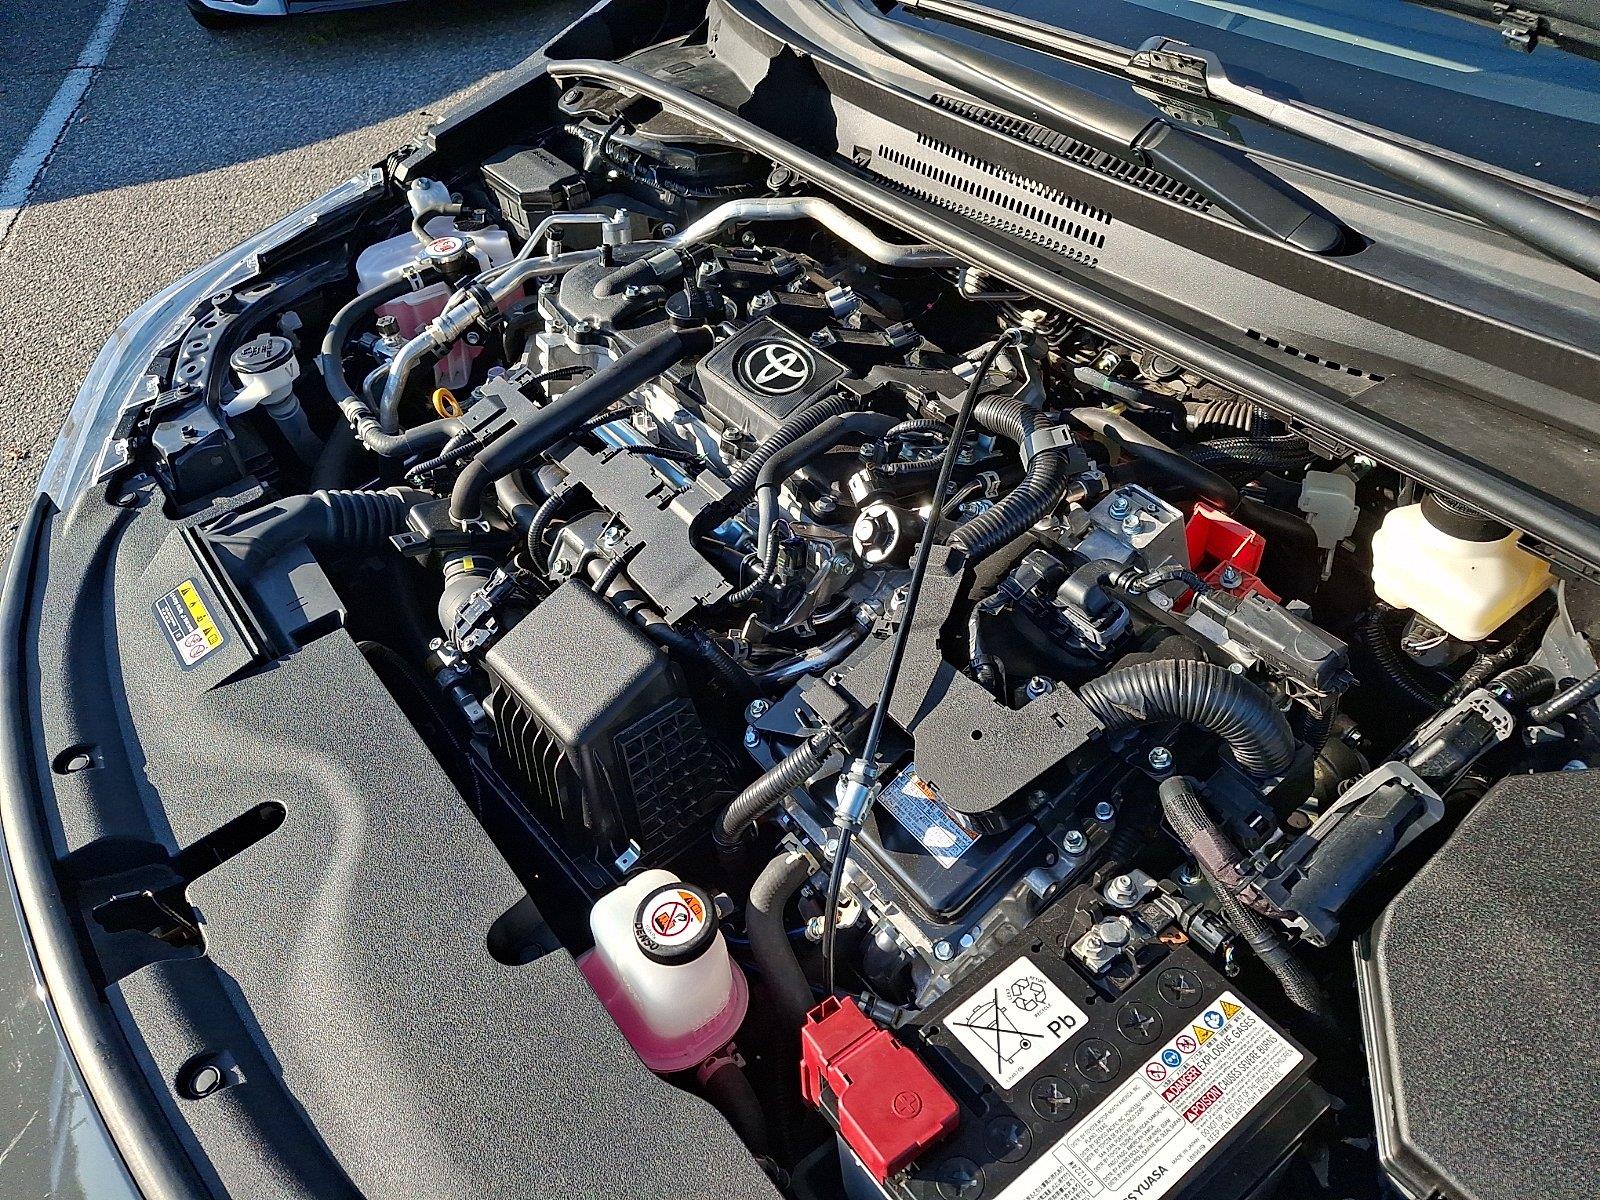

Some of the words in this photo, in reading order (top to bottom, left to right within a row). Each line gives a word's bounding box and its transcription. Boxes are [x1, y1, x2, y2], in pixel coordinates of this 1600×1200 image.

[635, 922, 660, 950] DENSO
[1047, 1013, 1076, 1038] Pb
[1170, 1065, 1200, 1096] DANGER
[1197, 1035, 1235, 1070] EXPLOSIVE
[1232, 1016, 1256, 1038] GASES
[1191, 1087, 1221, 1116] POISON
[1218, 1068, 1242, 1090] CAUSES
[1238, 1050, 1261, 1072] SEVERE
[1256, 1035, 1277, 1054] BURNS
[1133, 1166, 1168, 1196] YUASA
